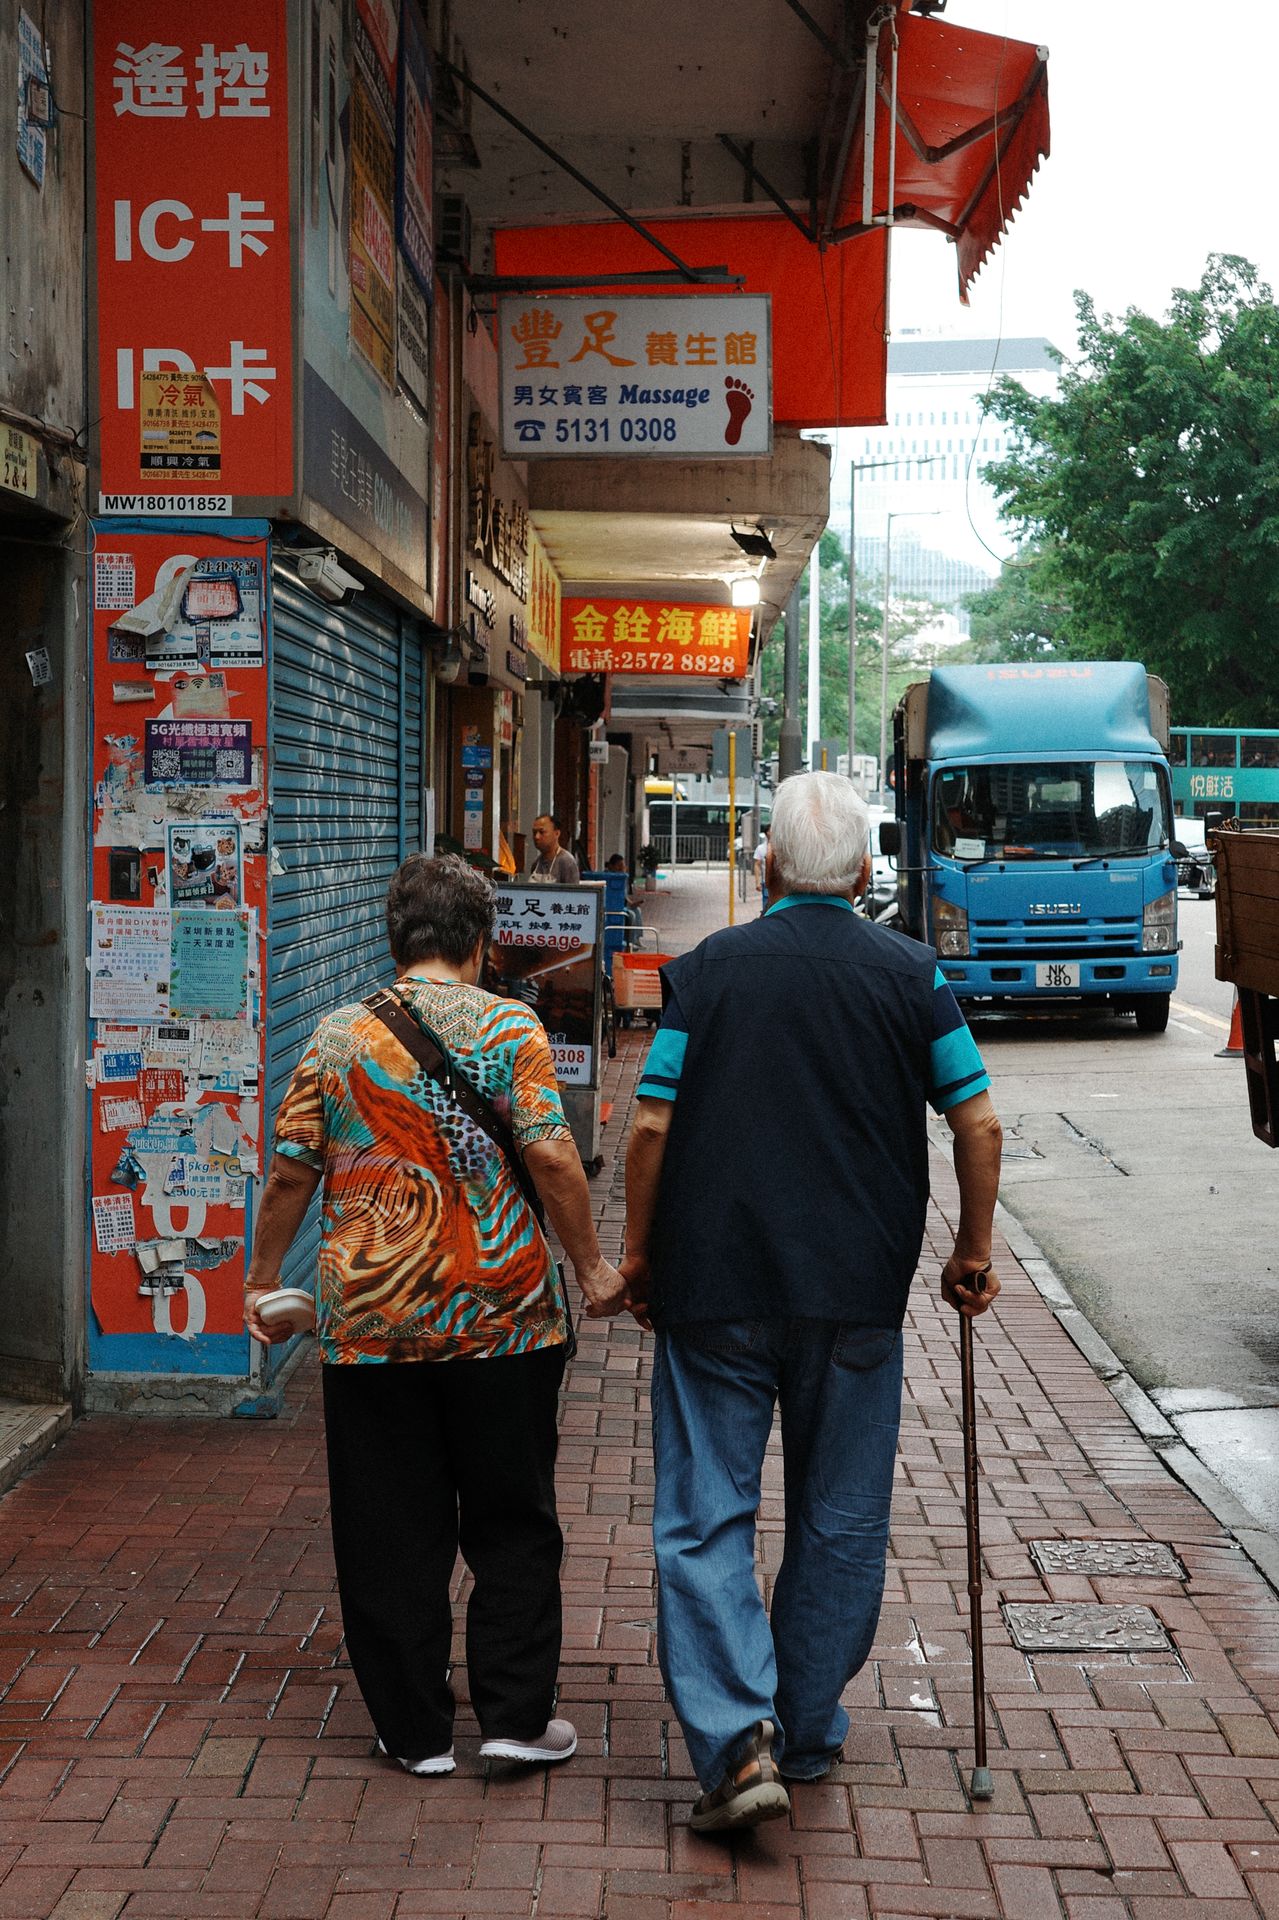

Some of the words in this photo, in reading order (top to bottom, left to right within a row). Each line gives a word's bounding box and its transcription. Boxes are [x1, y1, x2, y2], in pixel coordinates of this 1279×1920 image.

[112, 41, 270, 119] 遙控
[115, 193, 274, 267] IC卡
[511, 308, 638, 370] 豐足
[645, 331, 757, 366] 養生館
[158, 384, 205, 407] 冷氣
[514, 385, 607, 406] 男女賓客
[618, 384, 710, 408] Massage
[556, 418, 609, 442] 5131
[620, 418, 676, 442] 0308
[105, 496, 227, 511] MW180101852
[571, 604, 738, 648] 金銓海鮮
[681, 655, 736, 674] 8828
[988, 668, 1093, 680] ISUZU
[496, 896, 545, 917] 豐足
[550, 903, 590, 915] 養生館
[1029, 903, 1081, 914] ISUZU
[182, 926, 236, 936] 深圳新景點
[498, 929, 581, 951] Massage
[1049, 964, 1066, 975] NK
[1045, 976, 1071, 986] 380
